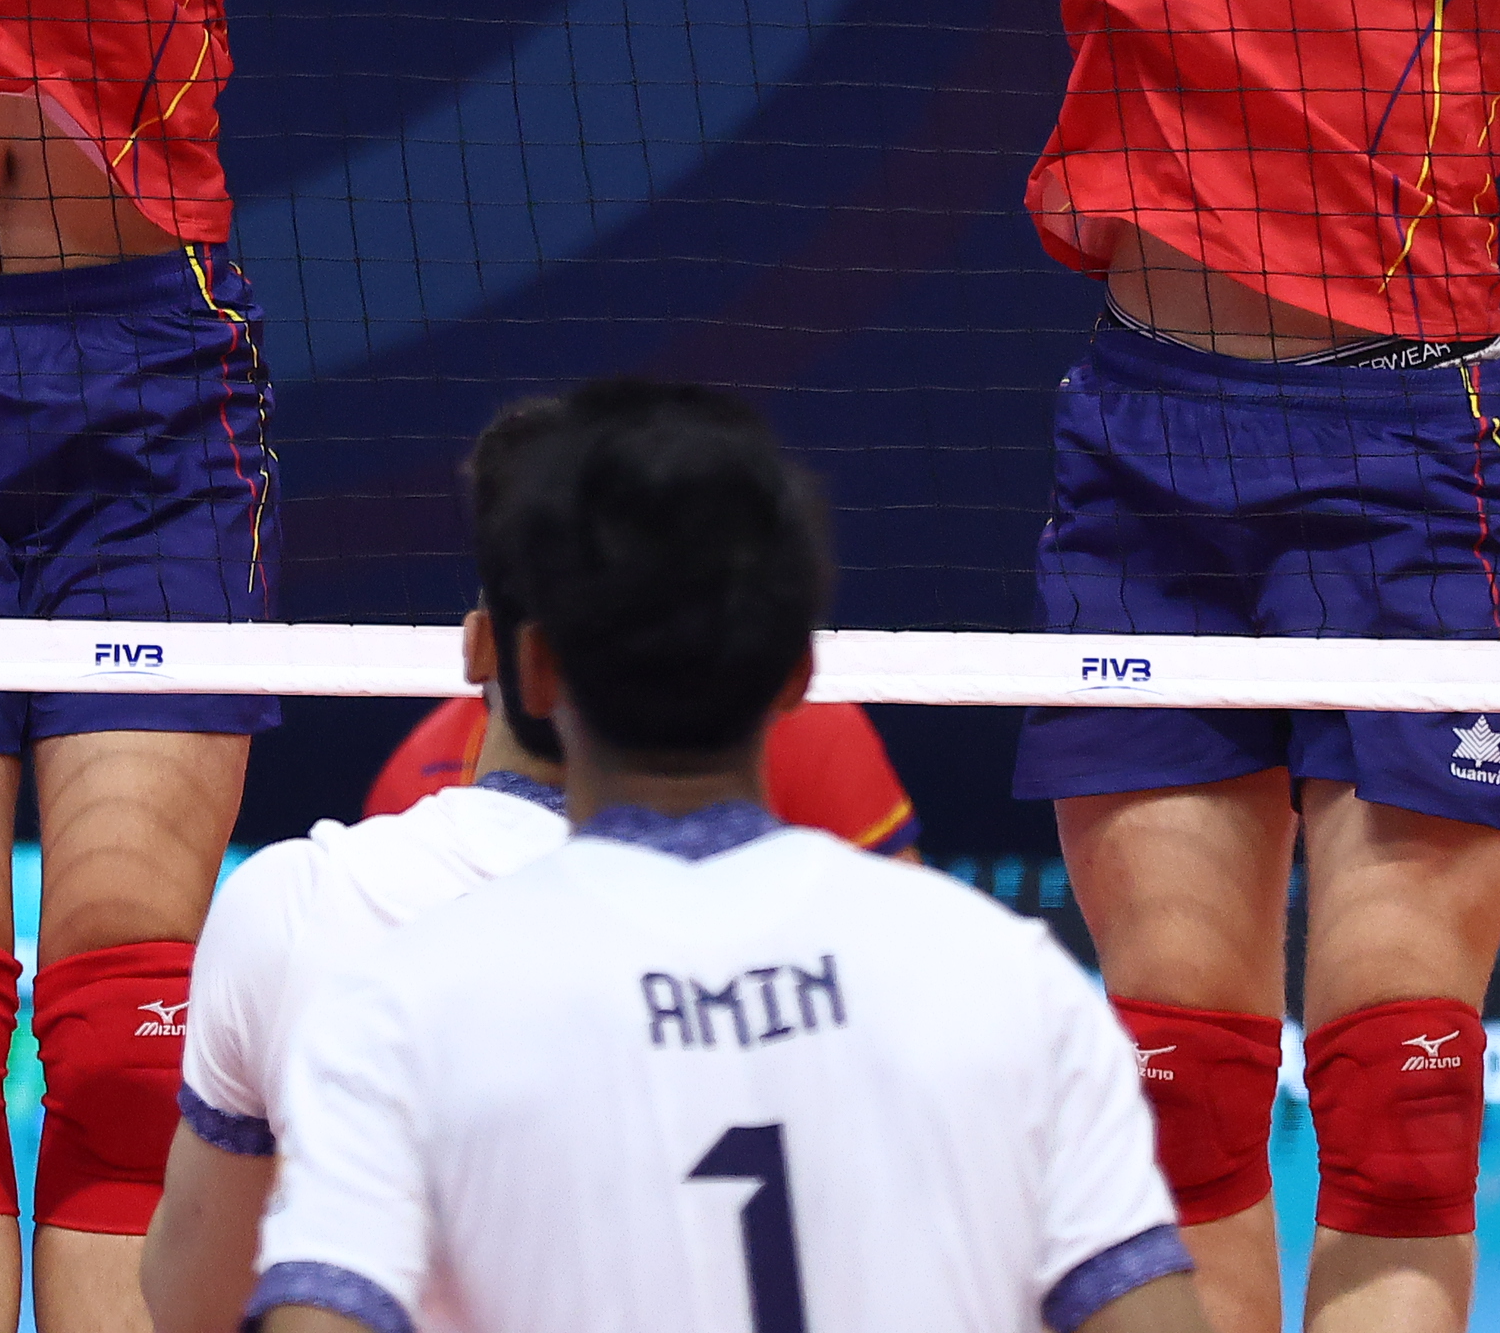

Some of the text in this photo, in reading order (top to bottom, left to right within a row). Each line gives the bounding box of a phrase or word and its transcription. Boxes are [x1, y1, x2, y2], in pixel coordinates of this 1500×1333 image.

[95, 643, 163, 668] FIVB
[1082, 657, 1152, 682] FIVB
[639, 954, 849, 1050] AMIN
[134, 1022, 186, 1036] MIZUN
[682, 1123, 811, 1333] 1
